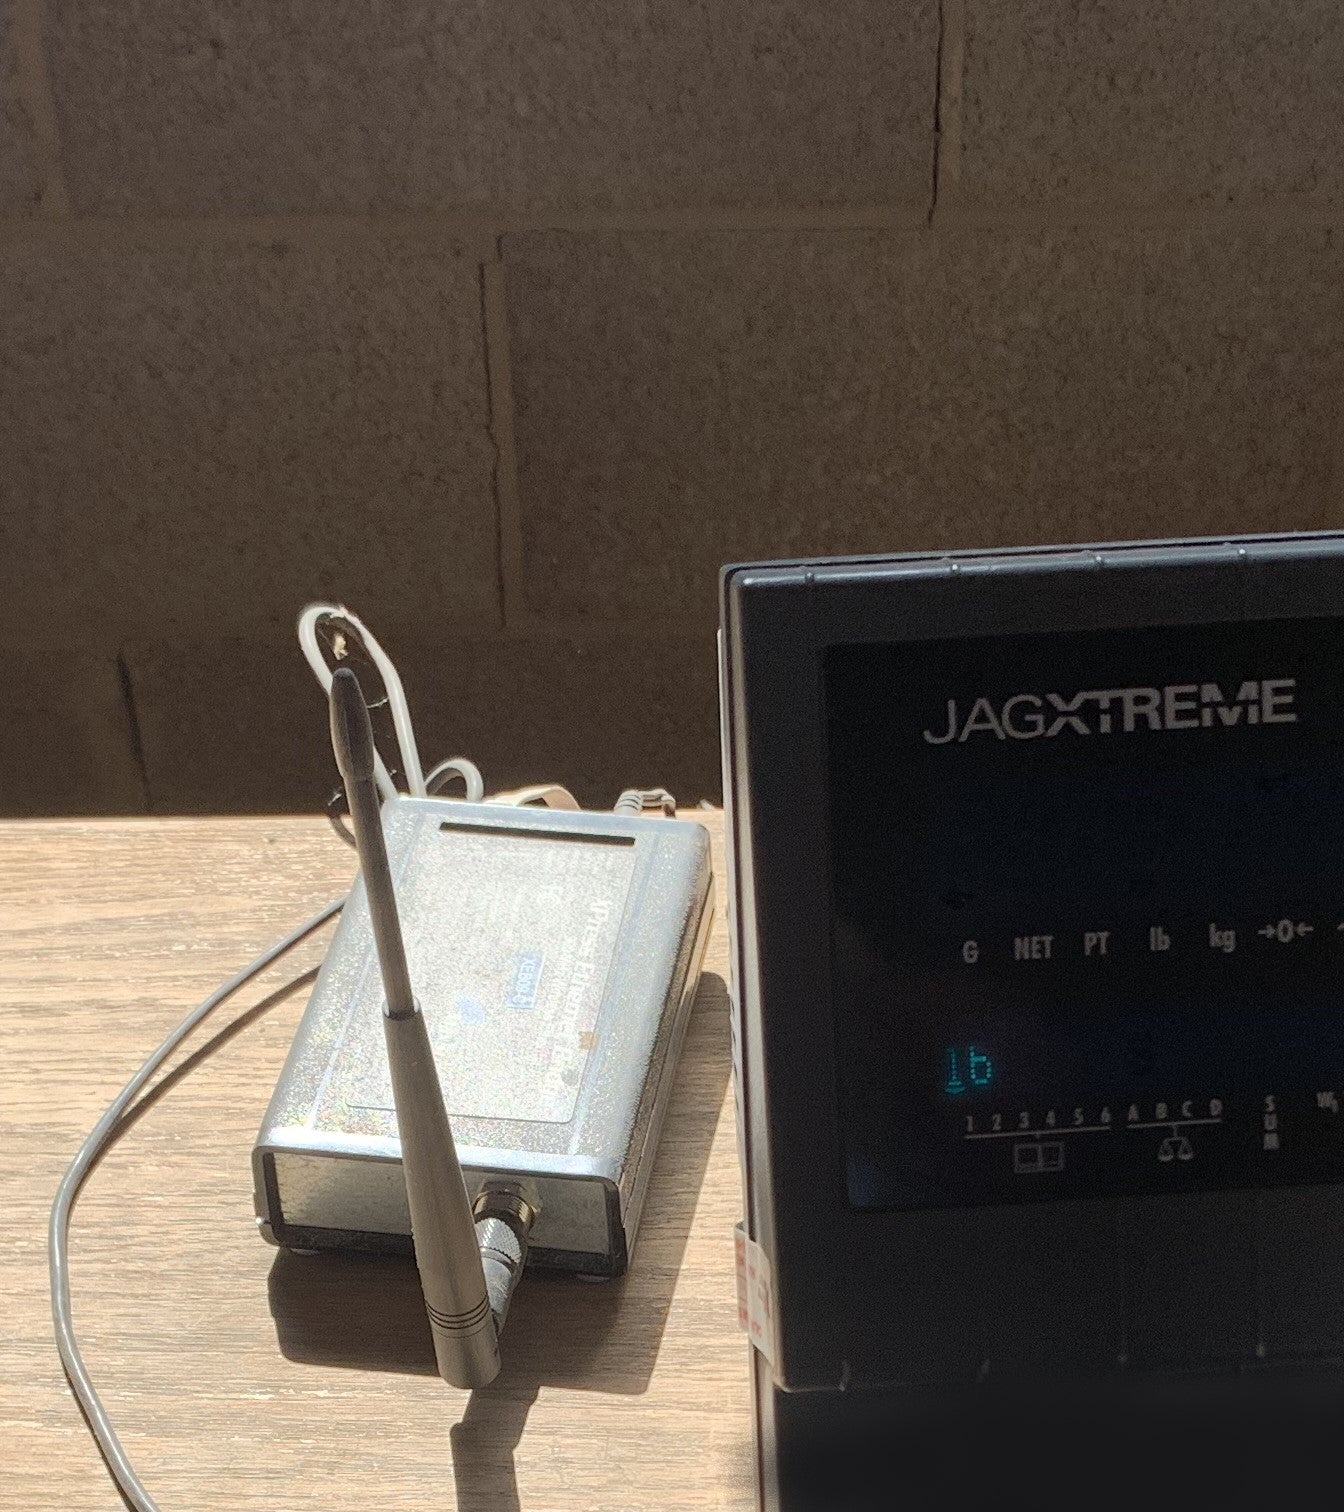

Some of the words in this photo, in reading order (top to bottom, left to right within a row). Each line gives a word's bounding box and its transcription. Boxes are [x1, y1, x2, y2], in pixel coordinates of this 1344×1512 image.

[923, 677, 1299, 745] JAGXTREME
[962, 940, 980, 964] G
[1013, 935, 1054, 961] NET
[1083, 930, 1111, 957] PT
[1149, 926, 1171, 952] lb
[1209, 922, 1237, 954] kg
[966, 1115, 974, 1132] 1
[992, 1113, 1002, 1131] 2
[1019, 1111, 1030, 1129] 3
[1045, 1109, 1056, 1127] 4
[1073, 1107, 1084, 1126] 5
[1100, 1106, 1111, 1124] 6
[1128, 1104, 1139, 1121] A
[1156, 1102, 1167, 1119] B
[1182, 1100, 1192, 1117] C
[1209, 1098, 1223, 1116] D
